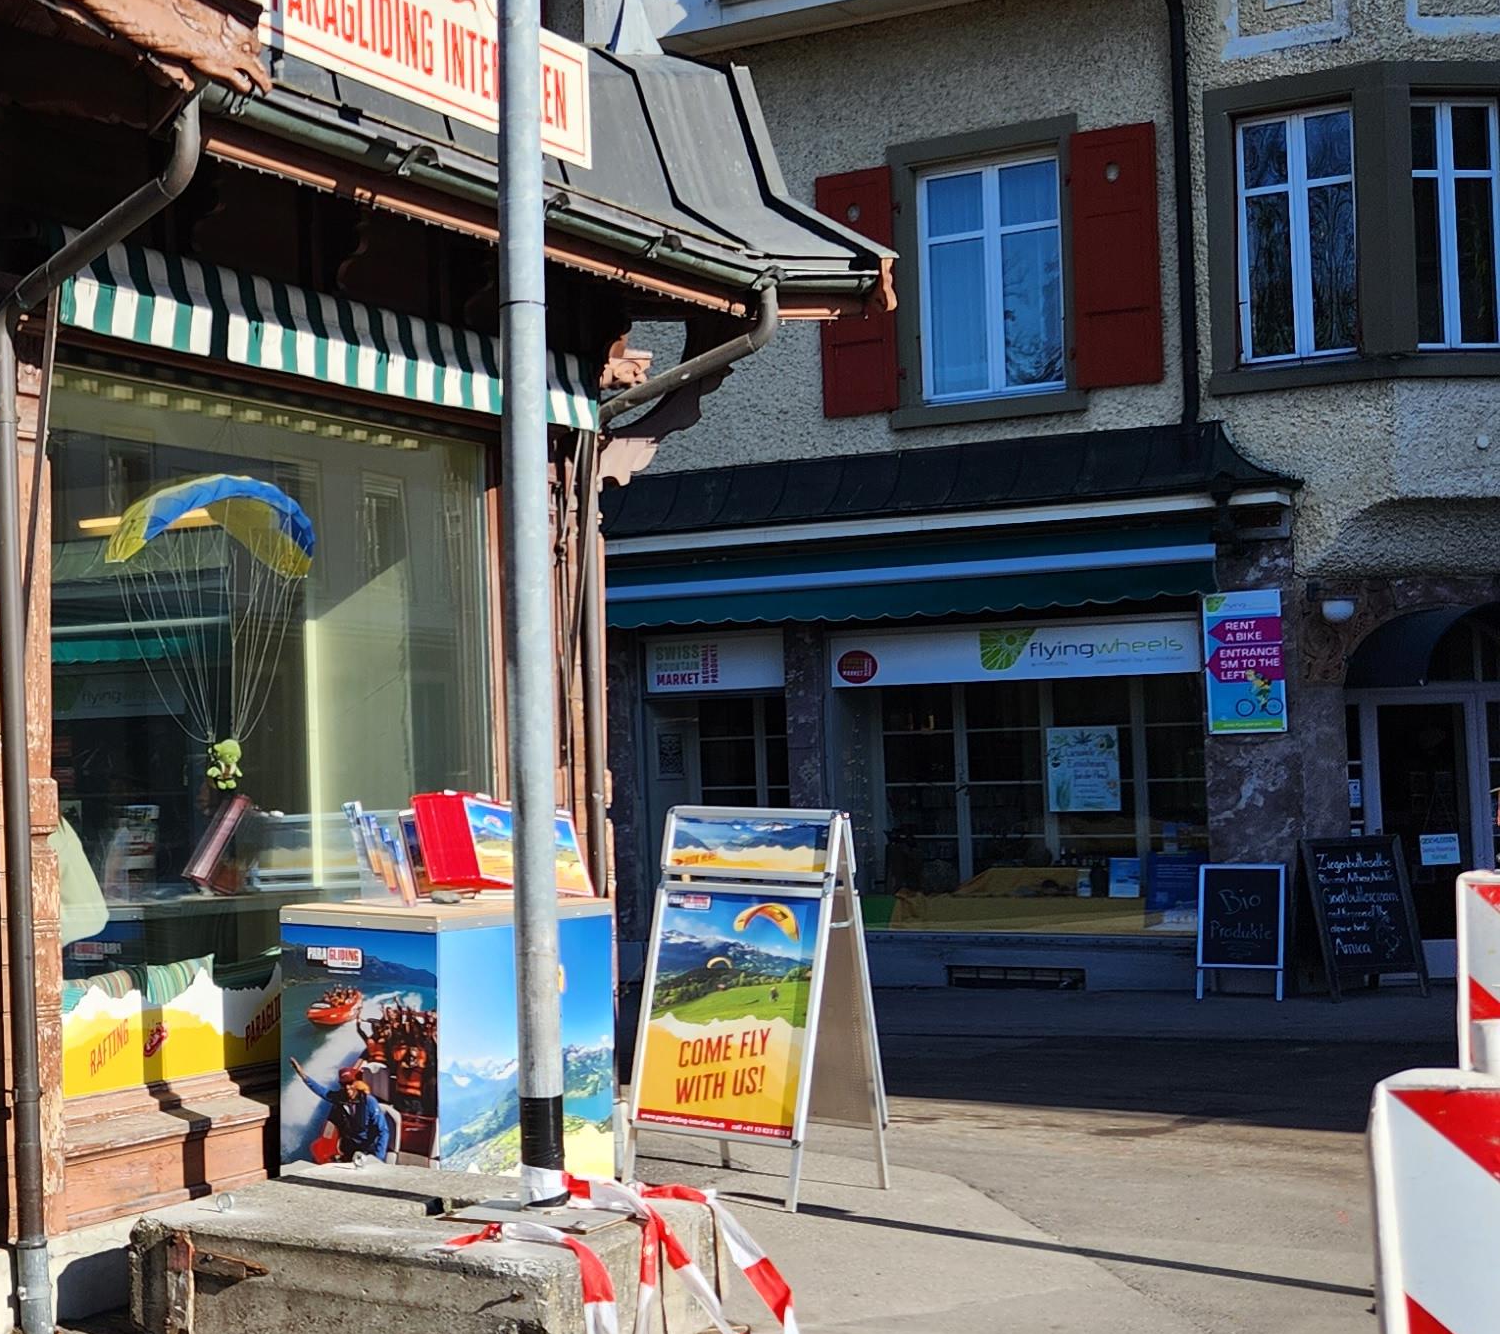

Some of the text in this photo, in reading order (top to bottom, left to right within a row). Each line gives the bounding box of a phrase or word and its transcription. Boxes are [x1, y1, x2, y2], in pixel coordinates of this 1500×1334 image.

[443, 18, 567, 131] INTEEN
[1225, 620, 1256, 631] RENT
[1225, 630, 1263, 642] A BIKE
[656, 645, 699, 660] SWISS
[1029, 635, 1184, 660] flyingwheels
[1219, 645, 1280, 658] ENTRANCE
[1241, 658, 1257, 669] TO
[1260, 657, 1280, 668] THE
[657, 673, 700, 686] MARKET
[1220, 669, 1246, 681] LEFT
[1217, 888, 1262, 916] Bio
[1210, 920, 1273, 941] Produkte
[328, 948, 360, 962] GLIDING
[90, 1018, 130, 1076] RAFTING
[678, 1028, 771, 1068] COME FLY
[676, 1066, 766, 1105] WITH US!
